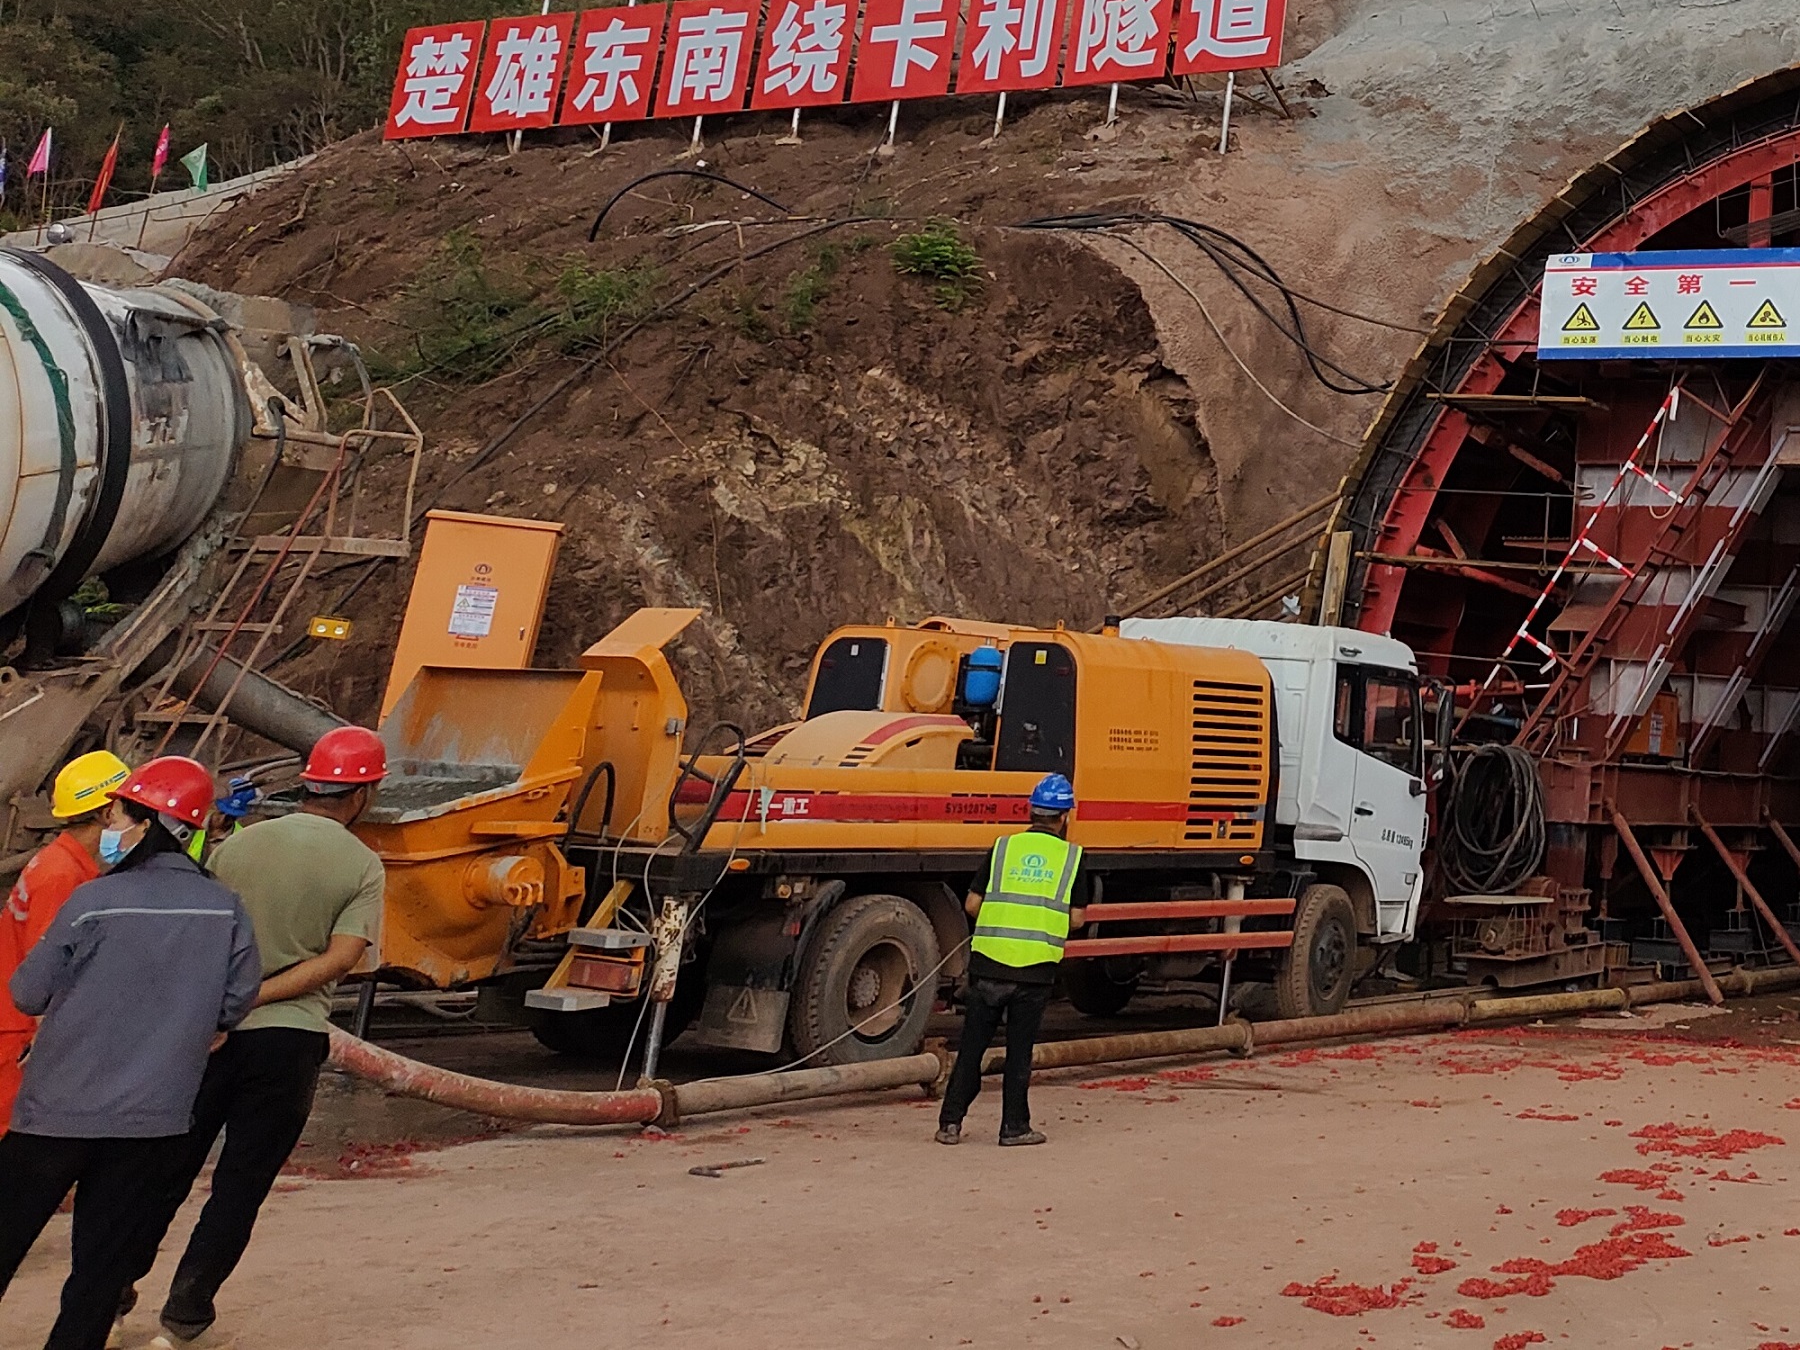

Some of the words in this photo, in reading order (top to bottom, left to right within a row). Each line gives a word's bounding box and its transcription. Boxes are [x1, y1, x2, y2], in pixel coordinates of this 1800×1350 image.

[1571, 273, 1757, 297] 安全第一
[1563, 335, 1597, 344] 当心坠落
[1624, 335, 1659, 343] 当心触电
[1685, 334, 1721, 342] 当心火灾
[1748, 333, 1785, 342] 当心机械伤人
[755, 797, 809, 815] 三一重工
[1008, 867, 1054, 879] 云南建投
